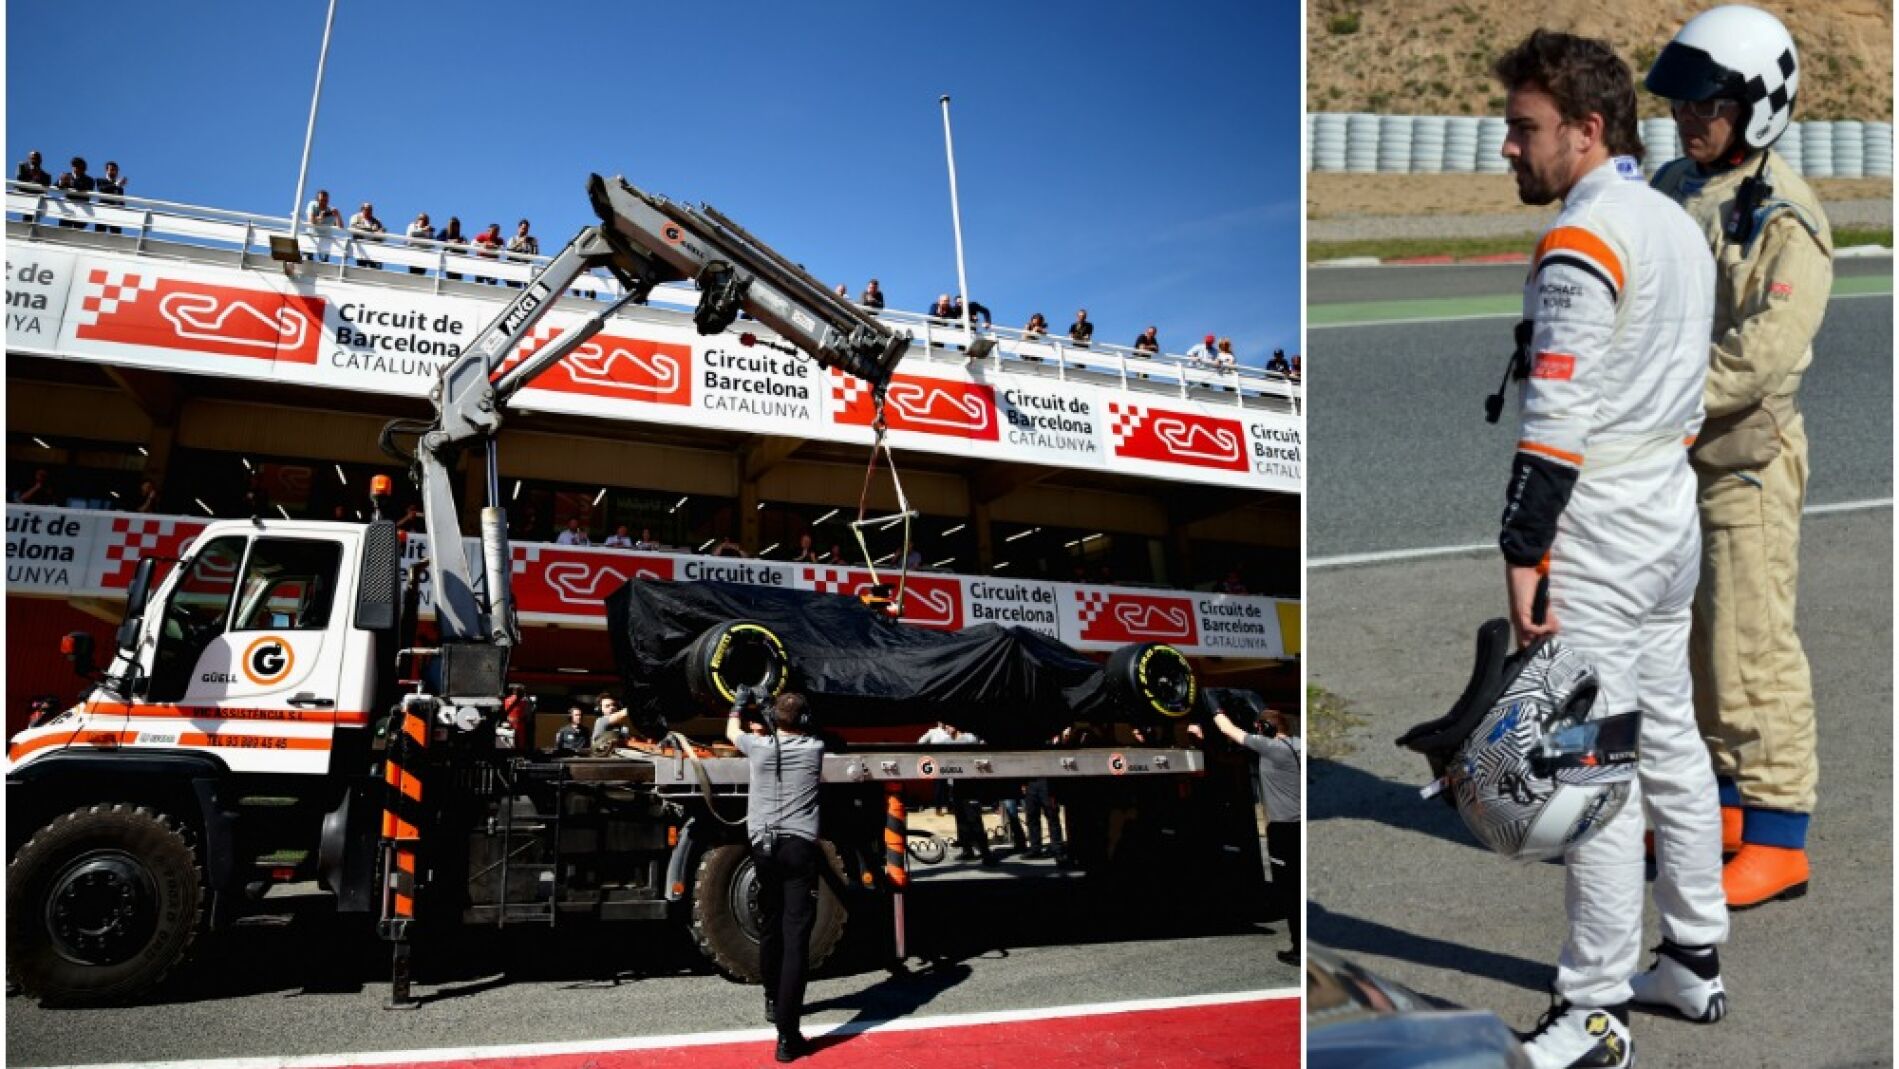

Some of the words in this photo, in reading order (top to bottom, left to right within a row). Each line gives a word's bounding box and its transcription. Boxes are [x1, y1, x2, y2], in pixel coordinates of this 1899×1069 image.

[19, 263, 54, 285] de
[339, 303, 428, 331] Circuit
[432, 315, 463, 335] de
[336, 327, 461, 358] Barcelona
[704, 349, 778, 374] Circuit
[782, 360, 808, 378] de
[704, 371, 809, 399] Barcelona
[704, 395, 810, 420] CATALUNYA
[1004, 389, 1066, 412] Circuit
[1069, 398, 1089, 414] de
[1008, 409, 1093, 434] Barcelona
[1008, 430, 1096, 452] CATALUNYA
[47, 515, 80, 537] de
[7, 565, 69, 585] UNYA
[685, 561, 754, 584] Circuit
[758, 567, 783, 586] de
[970, 582, 1028, 602] Circuit
[1032, 586, 1051, 604] de
[972, 603, 1055, 623] Barcelona
[1200, 600, 1244, 617] Circuit
[1245, 603, 1262, 618] de
[1202, 618, 1265, 634] Barcelona
[1205, 635, 1268, 649] CATALUNYA
[202, 673, 238, 684] GÜELL
